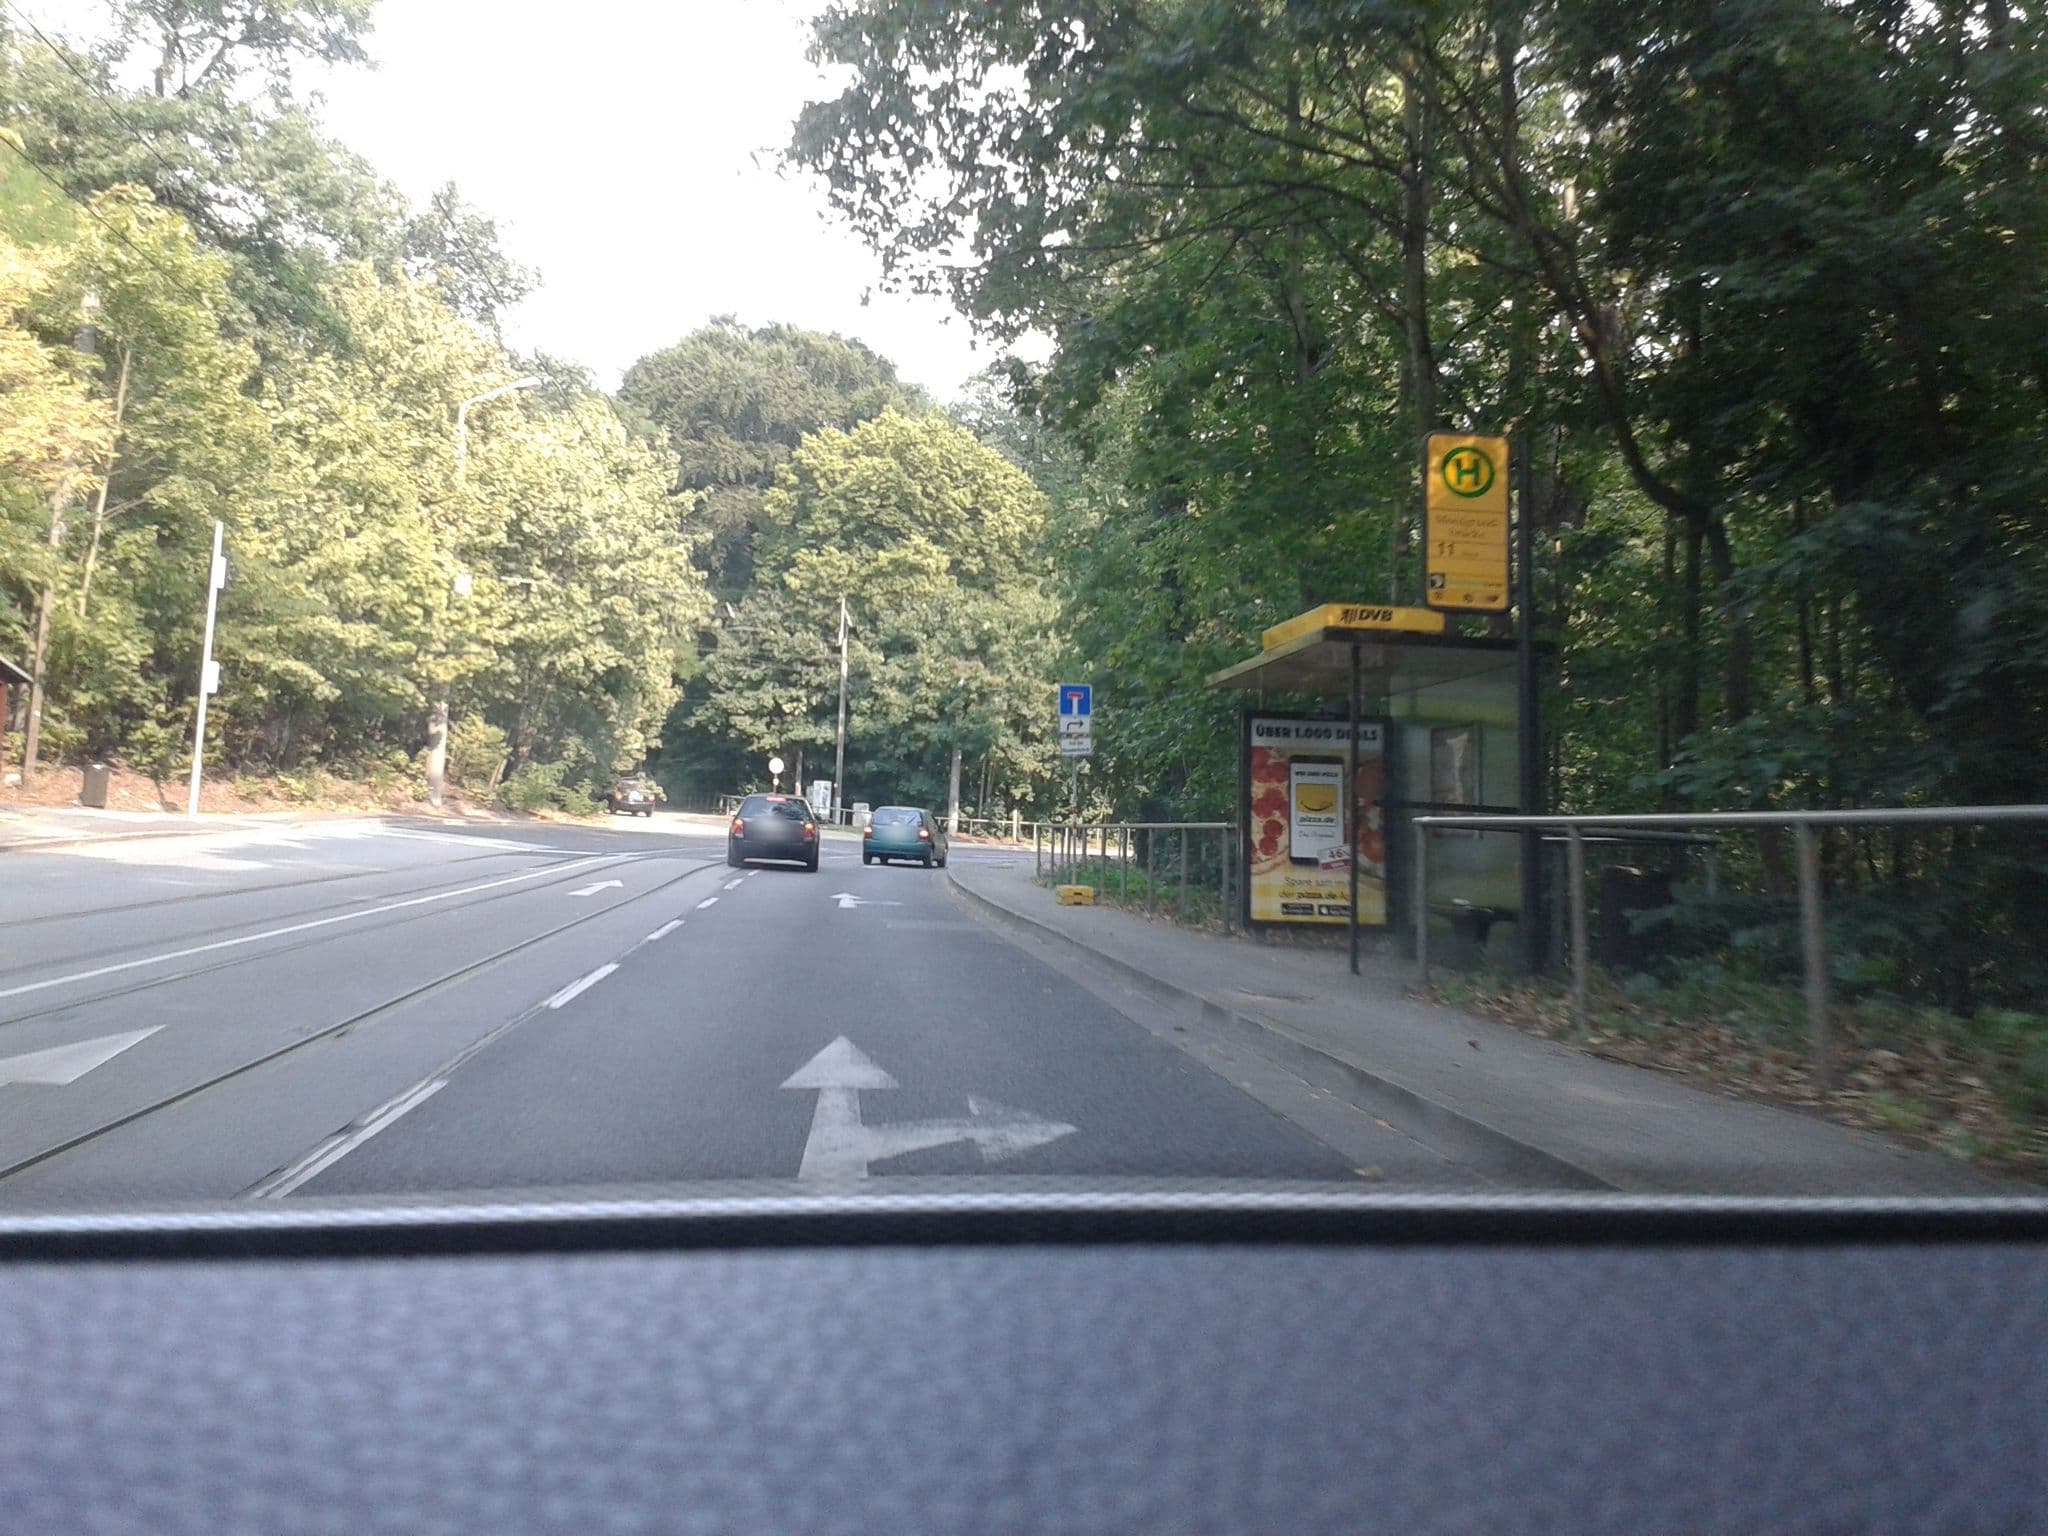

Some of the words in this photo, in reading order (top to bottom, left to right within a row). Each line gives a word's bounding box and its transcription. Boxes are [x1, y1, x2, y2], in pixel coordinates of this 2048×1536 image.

[1455, 458, 1481, 486] H
[1358, 609, 1394, 622] DVB
[1256, 723, 1292, 738] ÜBER
